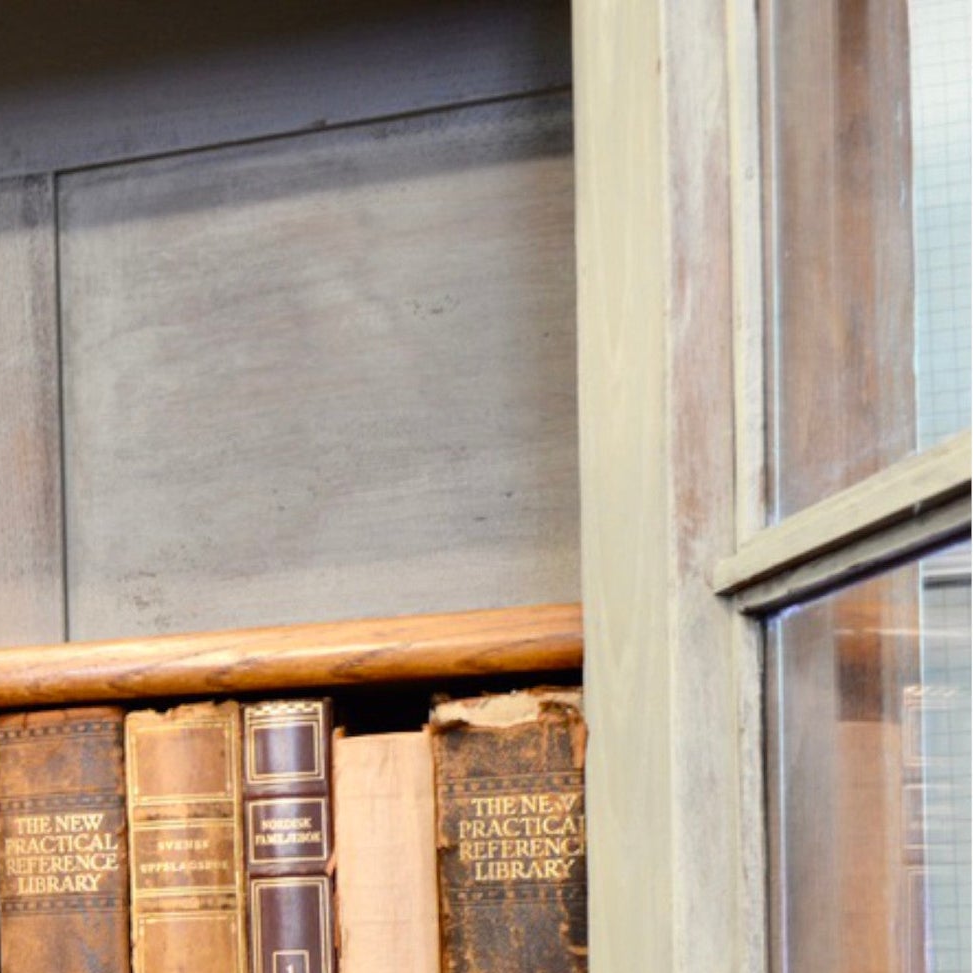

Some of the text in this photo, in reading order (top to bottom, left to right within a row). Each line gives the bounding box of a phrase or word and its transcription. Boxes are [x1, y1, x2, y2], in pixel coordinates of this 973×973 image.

[471, 792, 580, 817] THE NEW
[16, 812, 104, 835] THE NEW
[5, 832, 119, 857] PRACTICAL
[5, 852, 119, 877] REFERENCE
[475, 859, 575, 881] LIBRARY
[17, 872, 102, 896] LIBRARY
